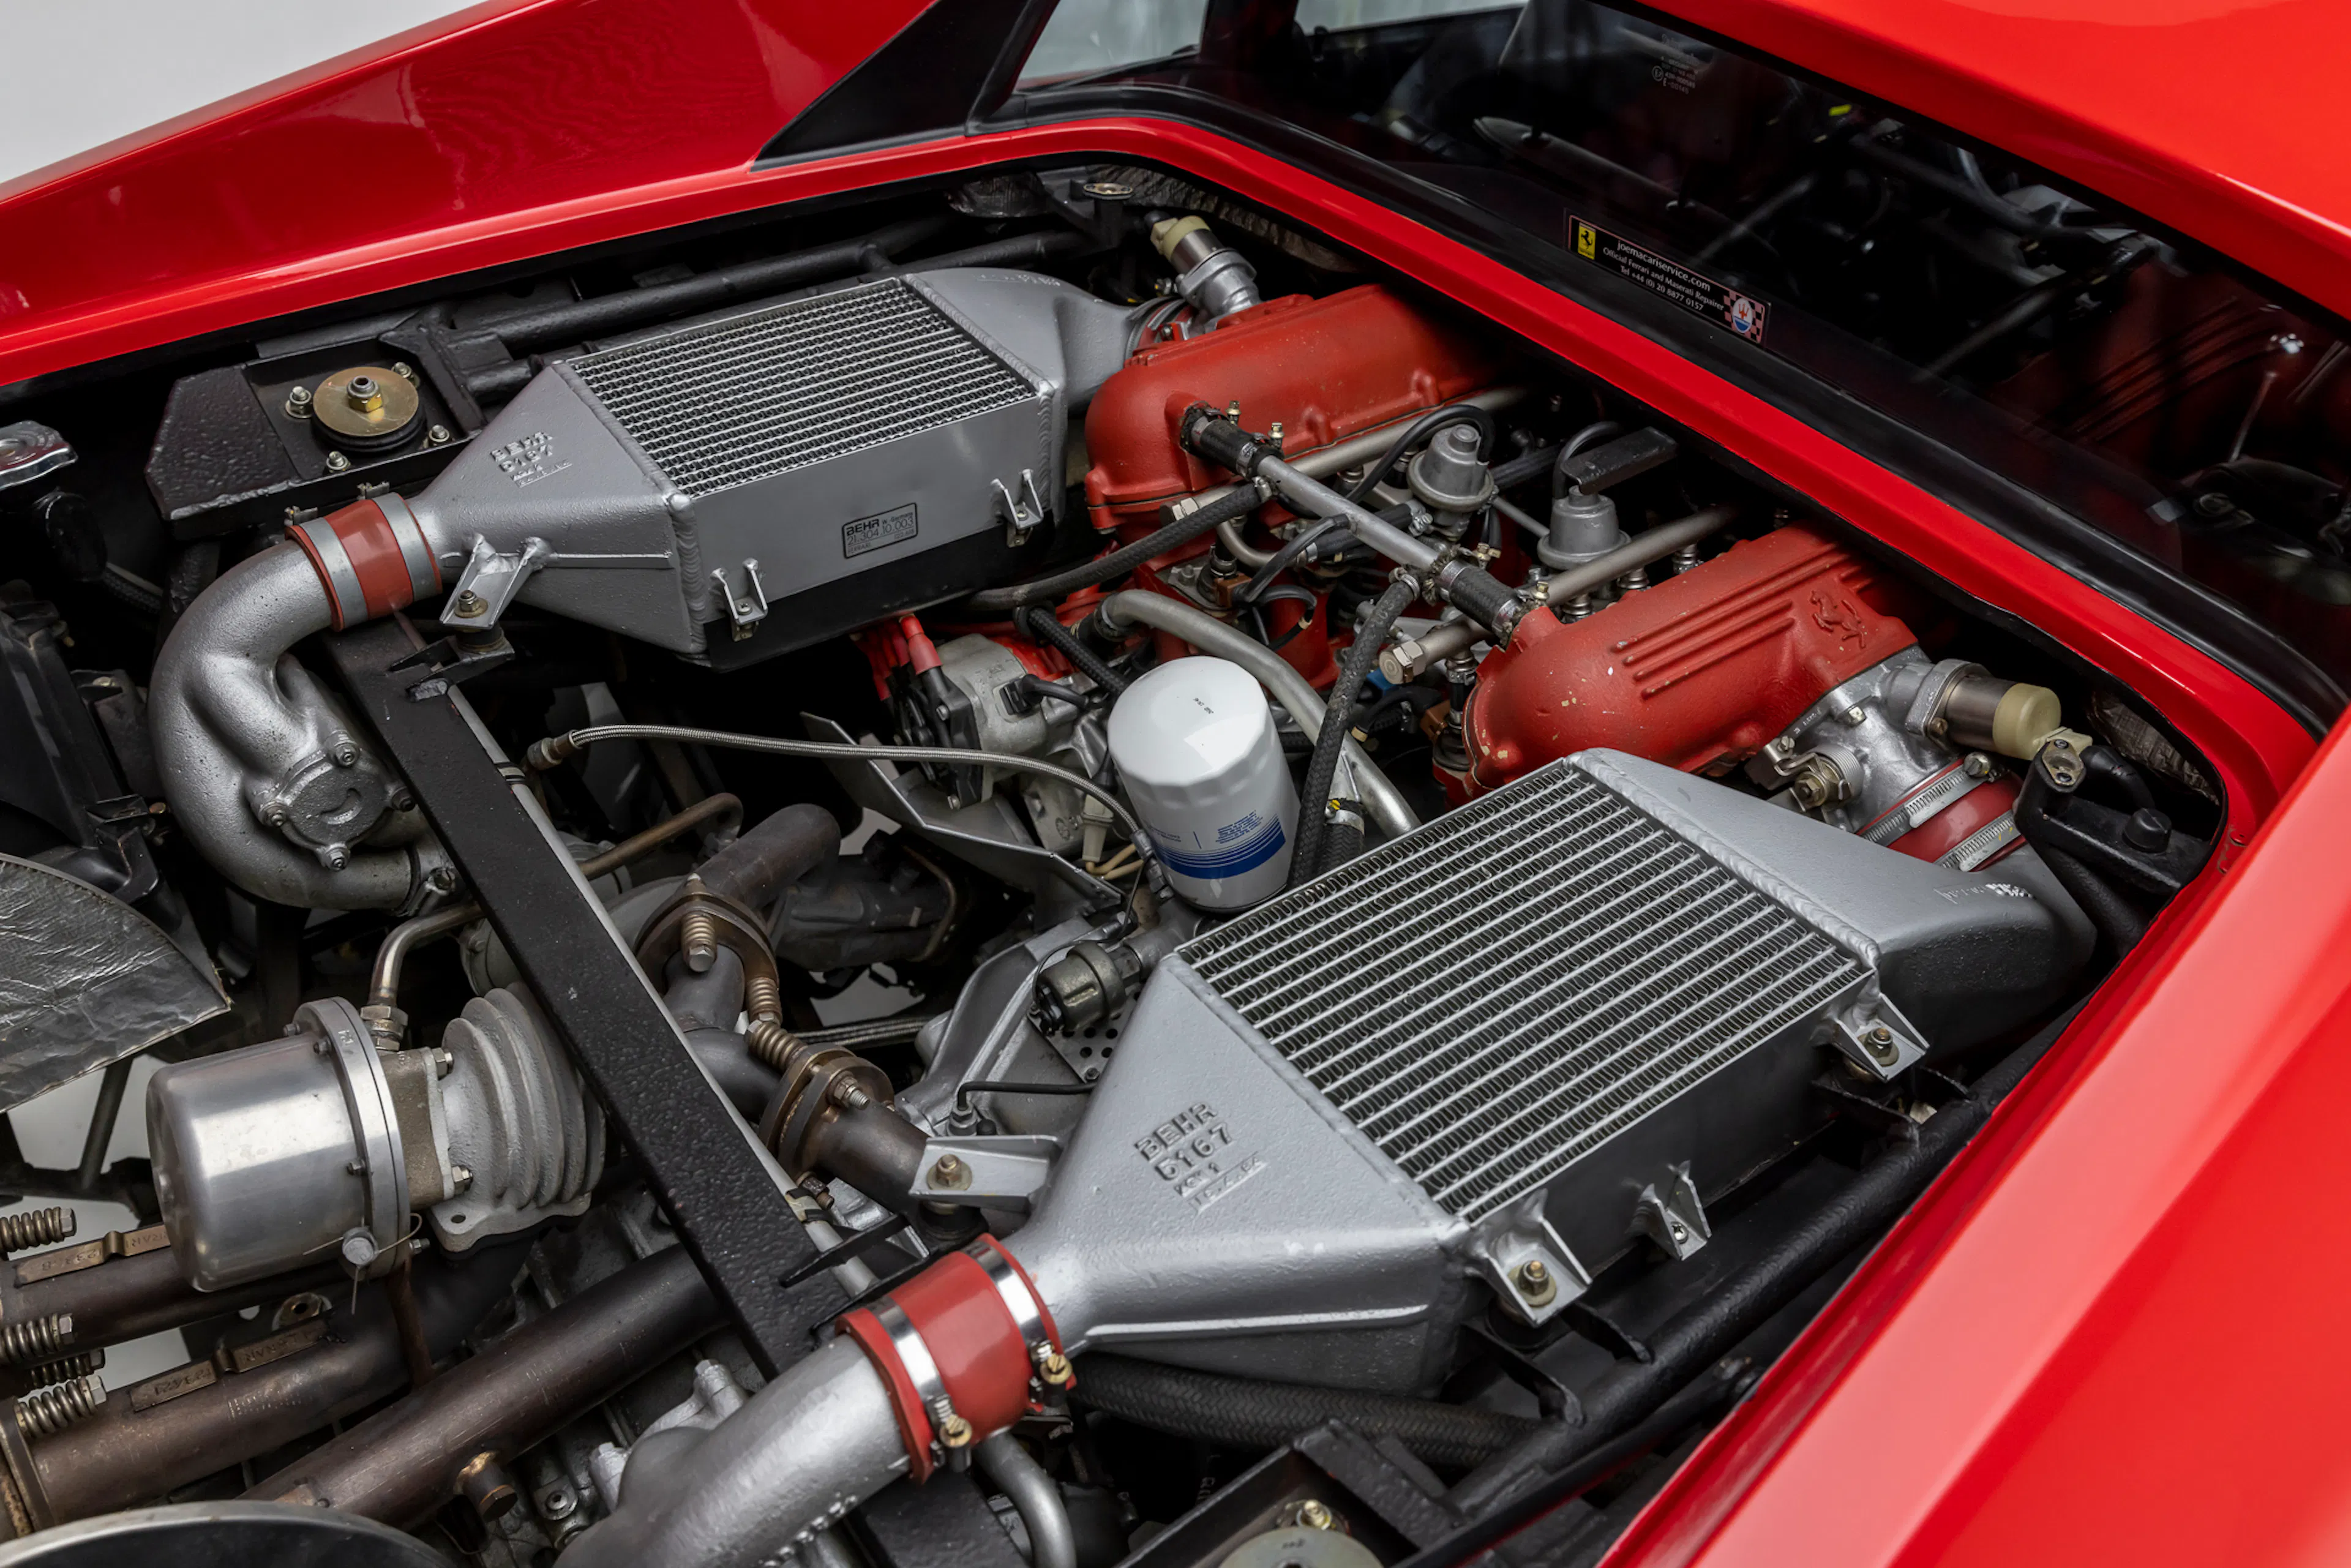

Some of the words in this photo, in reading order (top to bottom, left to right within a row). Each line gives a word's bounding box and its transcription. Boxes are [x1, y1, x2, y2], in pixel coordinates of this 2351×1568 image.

[1602, 247, 1628, 264] Official
[1628, 258, 1650, 276] Ferrari
[1651, 268, 1665, 282] and
[1665, 275, 1695, 295] Maserati
[1695, 288, 1725, 312] Repairer
[1617, 239, 1711, 293] joemacariservice.com
[1620, 264, 1630, 277] Tel
[1631, 271, 1645, 283] +44
[1645, 277, 1656, 290] (0)
[1656, 283, 1666, 294] 20
[1666, 287, 1685, 302] 8877
[1685, 297, 1704, 311] 0157
[846, 519, 880, 536] BEHR
[1134, 1102, 1218, 1162] BEHR
[1154, 1122, 1232, 1181] 5167
